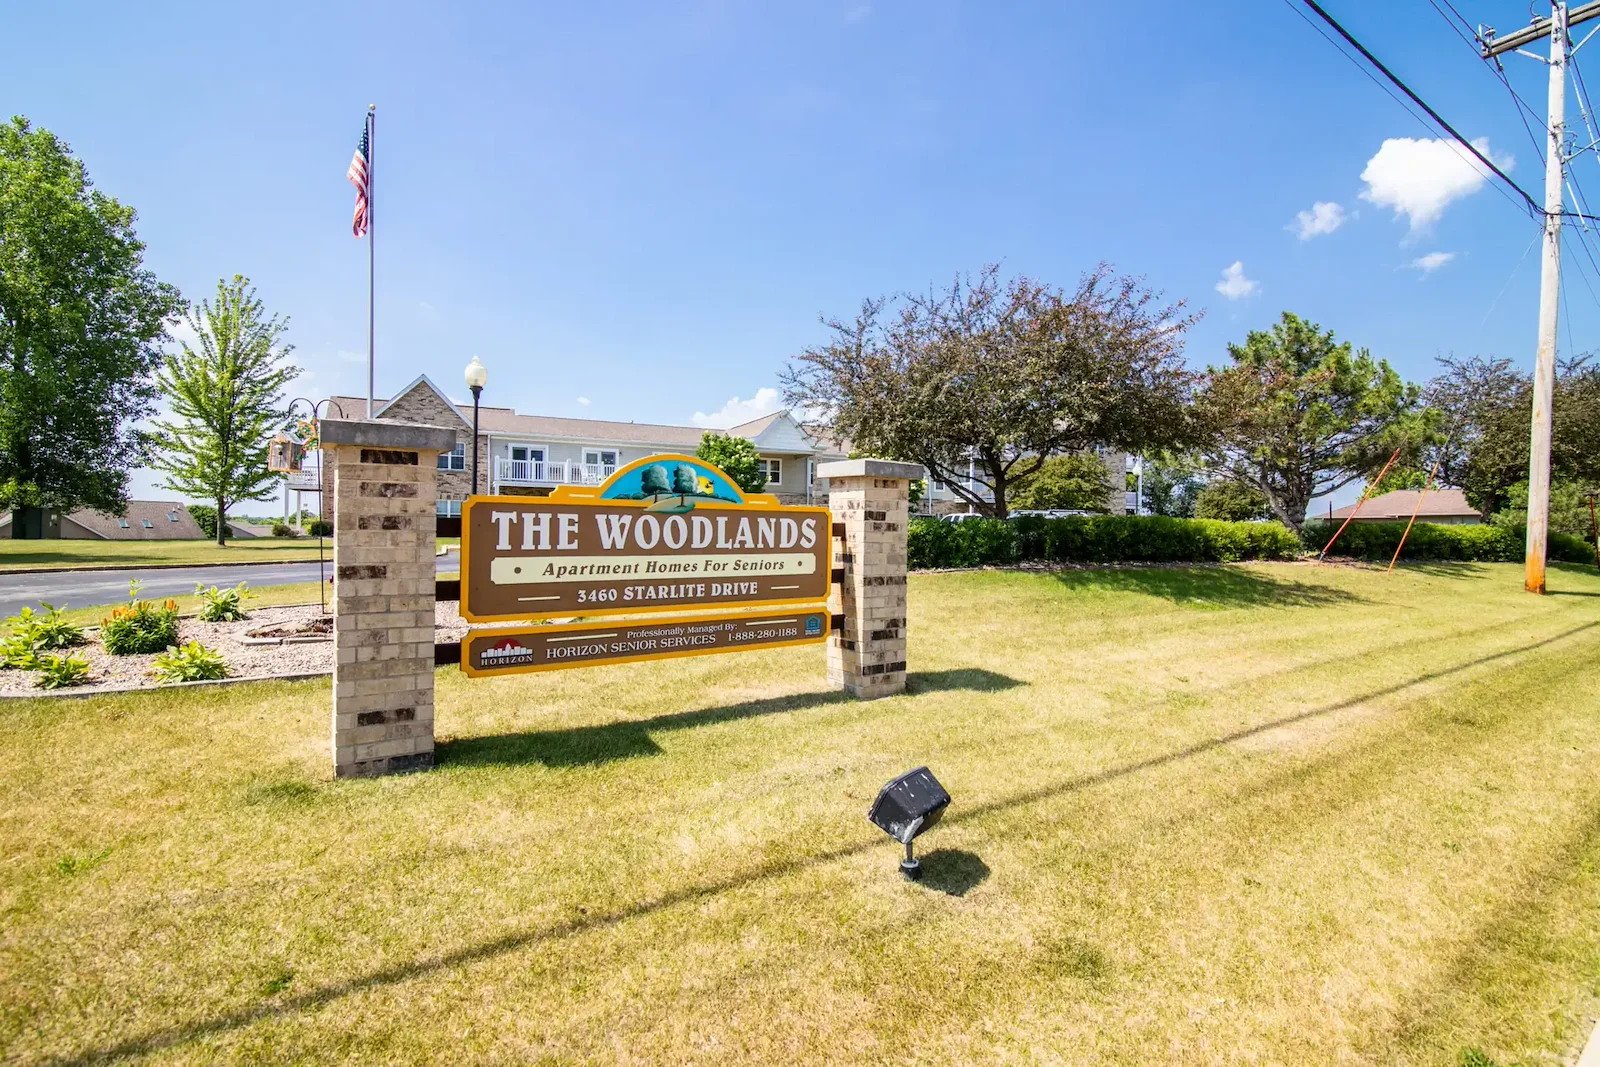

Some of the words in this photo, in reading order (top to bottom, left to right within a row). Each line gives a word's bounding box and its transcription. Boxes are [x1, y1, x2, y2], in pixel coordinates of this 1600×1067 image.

[492, 511, 579, 550] THE
[595, 514, 817, 550] WOODLANDS
[542, 562, 640, 579] Apartment
[646, 560, 698, 574] Homes
[703, 560, 728, 573] For
[732, 559, 785, 572] Seniors
[577, 588, 618, 603] 3460
[623, 584, 706, 601] STARLITE
[710, 582, 758, 596] DRIVE
[627, 628, 686, 640] Professionally
[687, 625, 723, 636] Managed
[725, 623, 738, 633] By:
[546, 643, 608, 659] HORIZON
[610, 639, 658, 653] SENIOR
[660, 634, 716, 649] SERVICES
[480, 654, 534, 666] HORIZON
